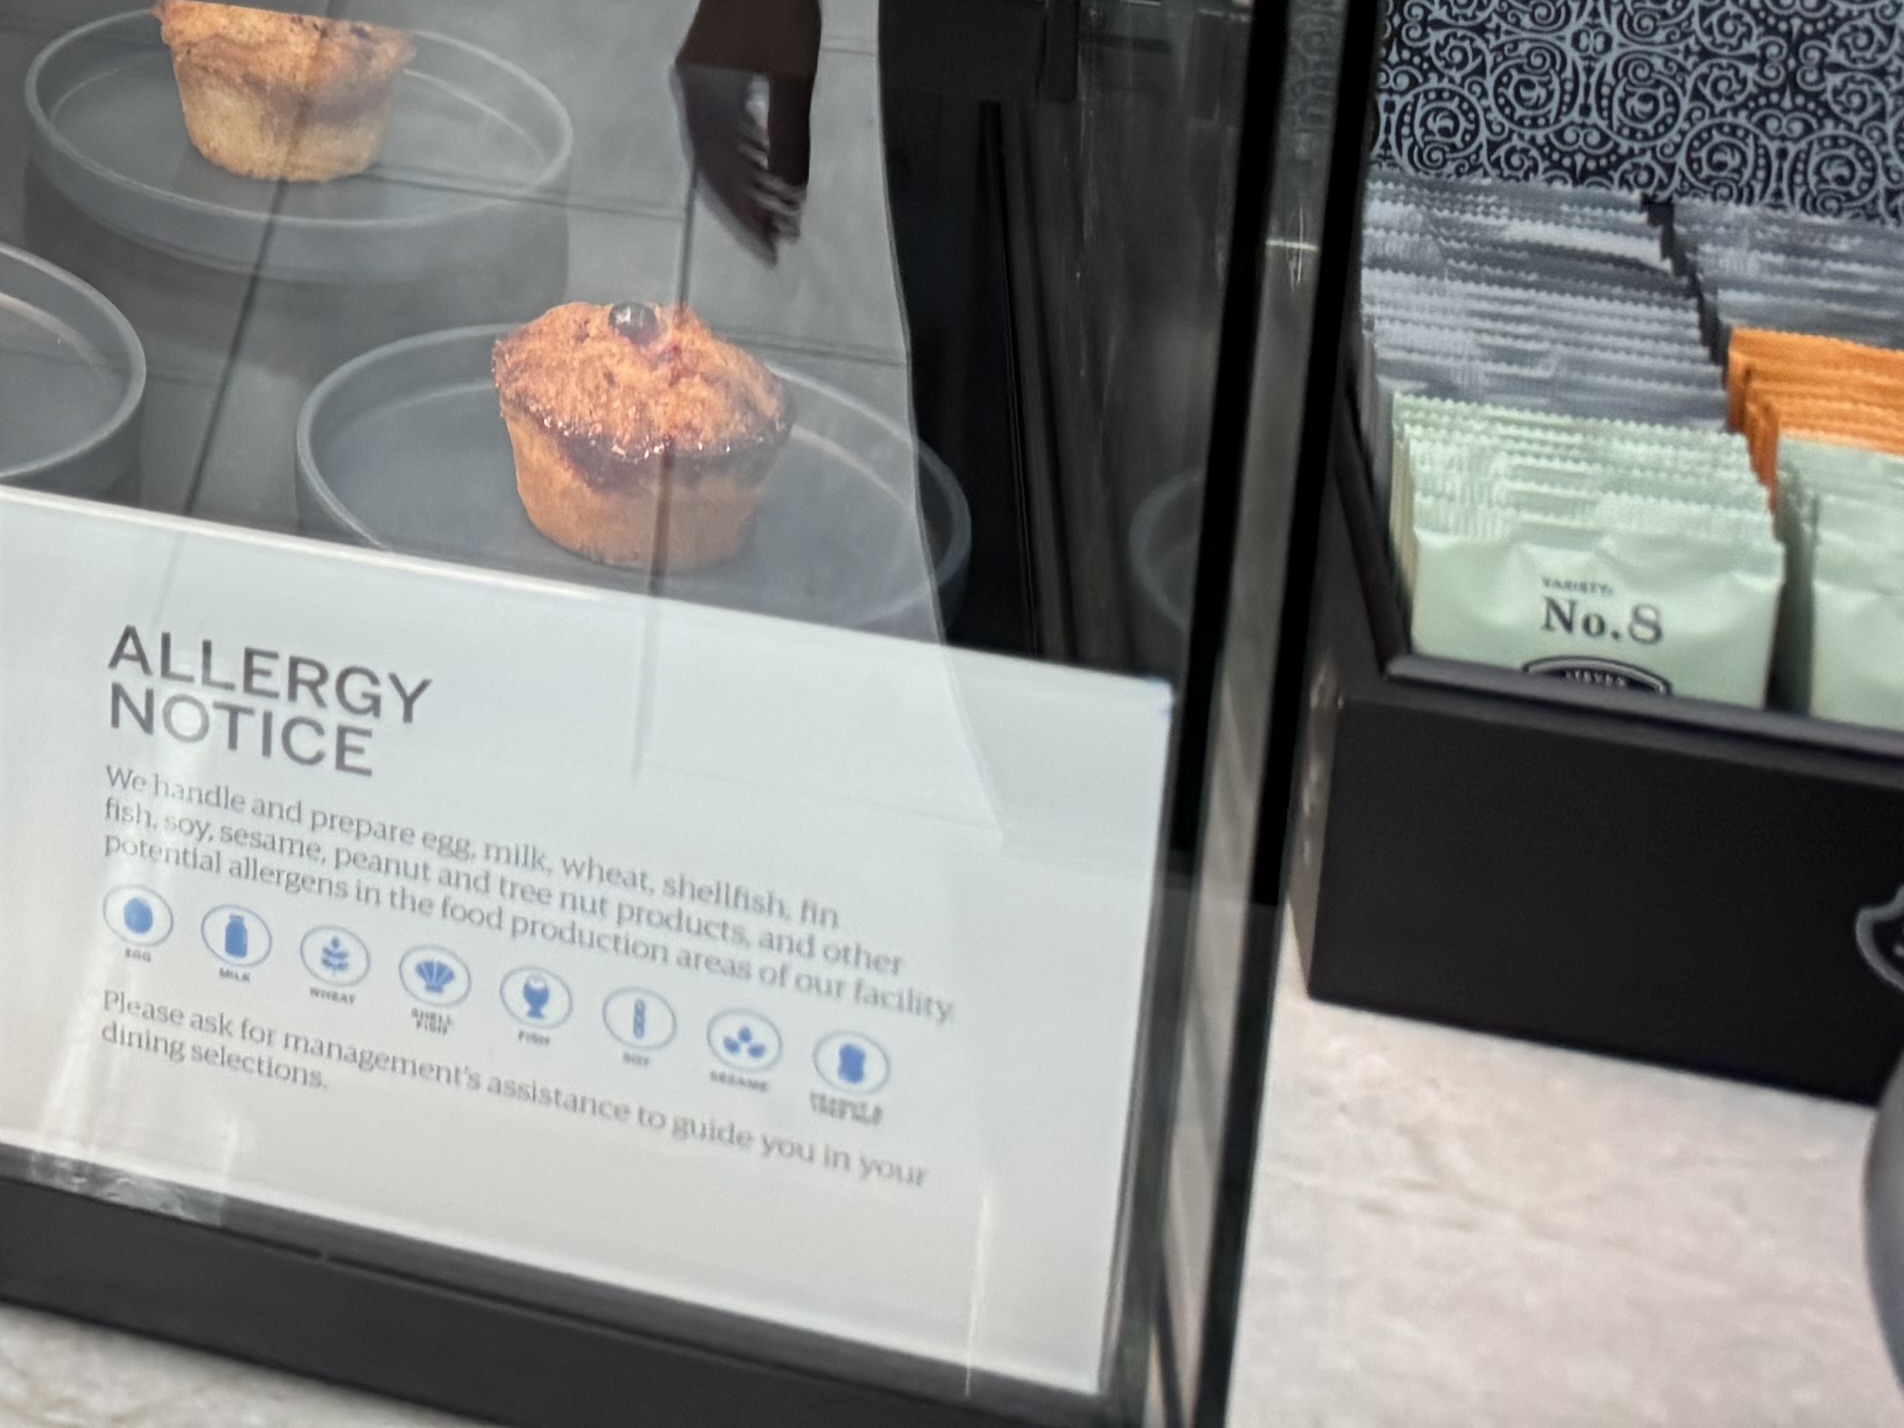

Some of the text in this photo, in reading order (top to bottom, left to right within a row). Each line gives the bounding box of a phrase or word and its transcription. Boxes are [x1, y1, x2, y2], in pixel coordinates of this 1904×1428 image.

[108, 625, 432, 724] ALLERGY
[110, 682, 373, 777] NOTICE
[104, 833, 221, 873] potential
[229, 855, 349, 901] allergens
[356, 879, 382, 905] in
[390, 887, 433, 916] the
[440, 898, 503, 930] food
[510, 911, 669, 964] production
[677, 948, 752, 980] areas
[759, 962, 787, 988] of
[795, 974, 845, 1000] our
[105, 797, 904, 976] fish, soy, sesame, peanut and tree nut products, and other
[106, 765, 840, 929] We handle and prepare egg, milk, wheat, shellfish, fin
[102, 1021, 327, 1091] dining selections.
[103, 989, 927, 1189] Please ask for management's assistance to guide you in your
